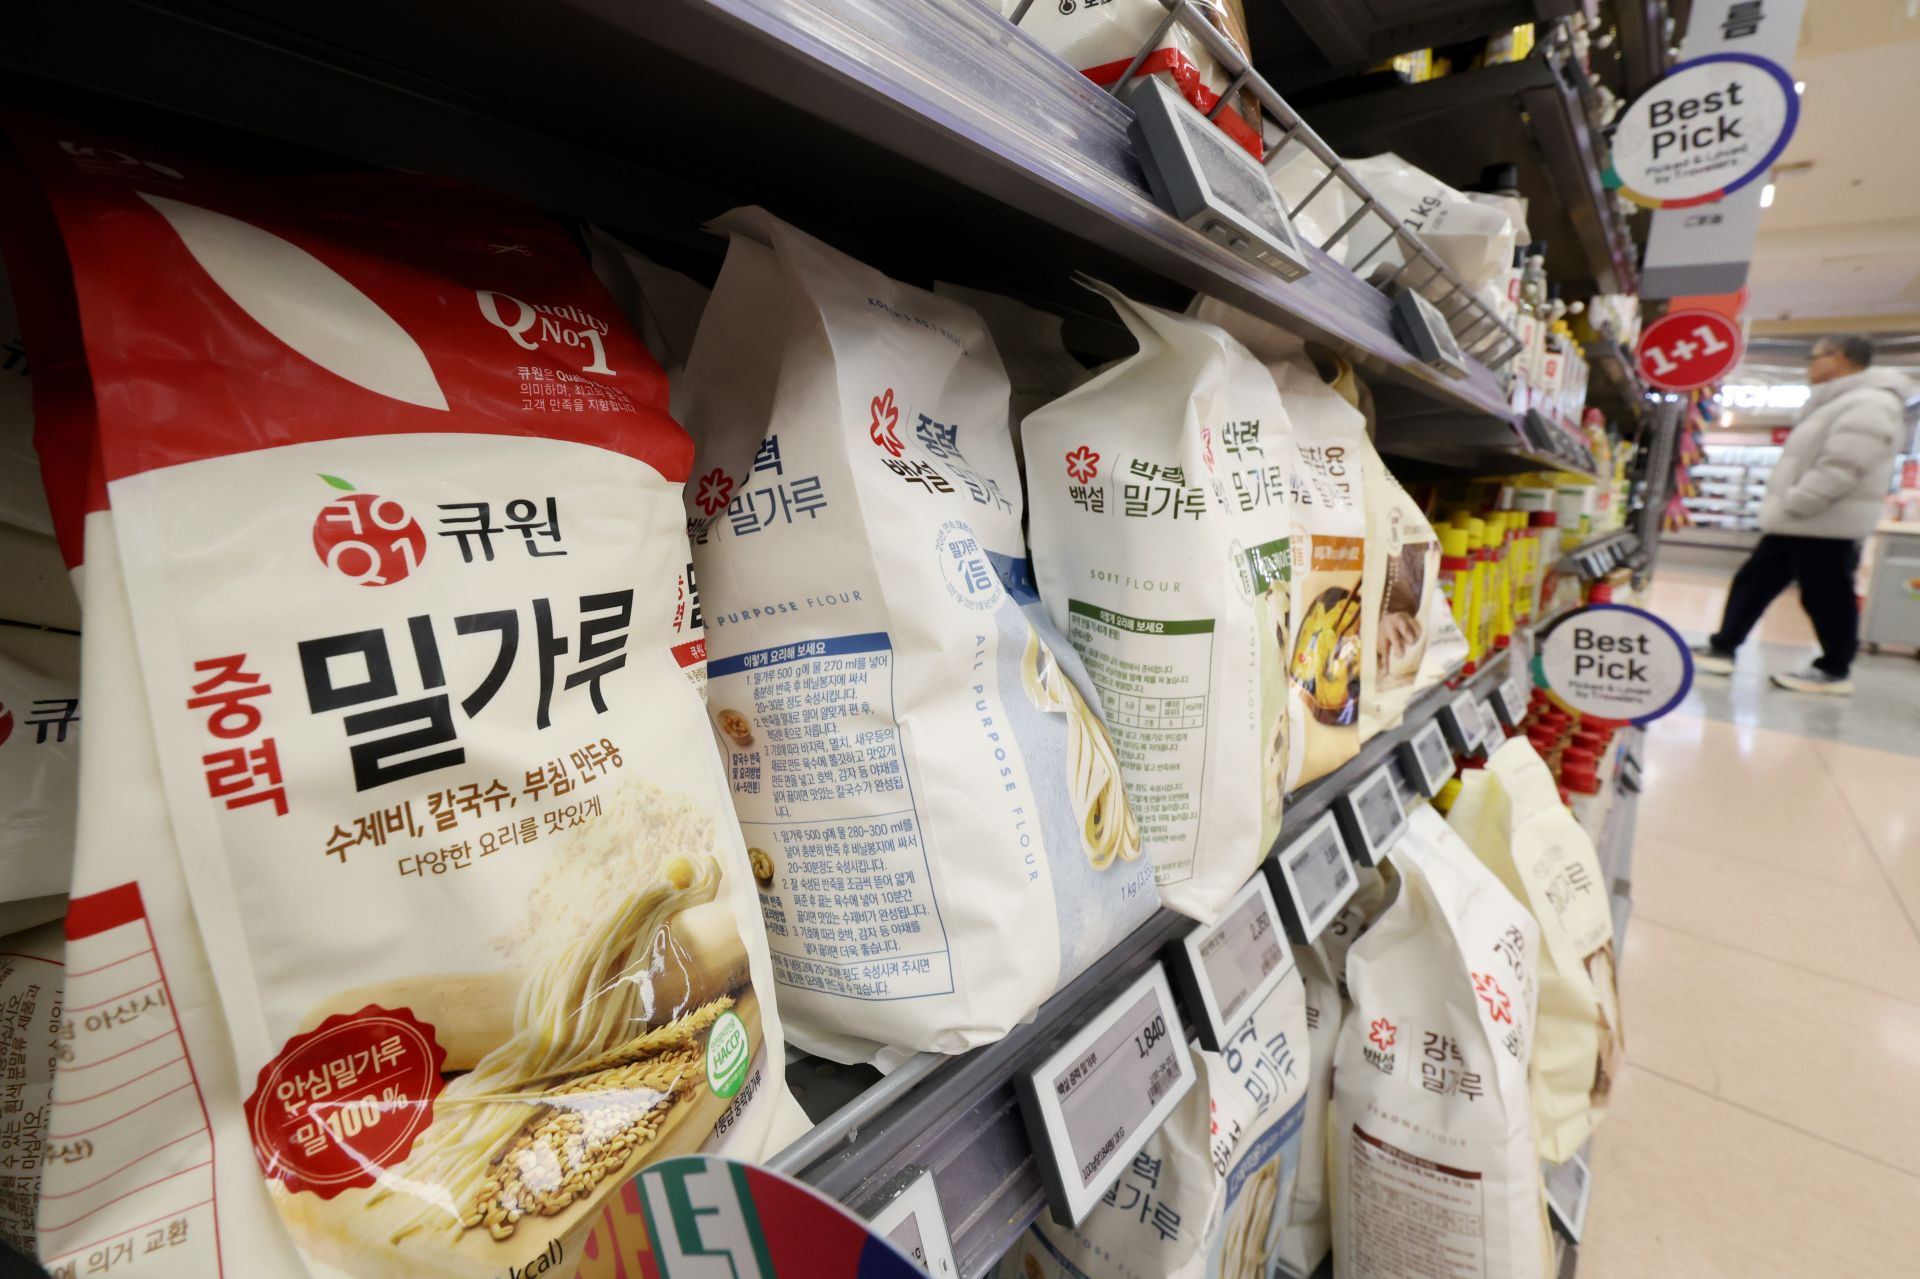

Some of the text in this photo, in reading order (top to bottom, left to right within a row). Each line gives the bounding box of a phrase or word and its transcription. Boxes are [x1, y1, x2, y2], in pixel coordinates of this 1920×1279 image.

[1649, 81, 1743, 129] Best
[1653, 116, 1742, 159] Pick
[476, 290, 609, 351] Quality
[541, 317, 617, 376] No.1
[1646, 325, 1728, 377] 1+1
[517, 366, 555, 381] 큐원은
[520, 383, 572, 398] 의미하며,
[521, 398, 639, 415] 고객 만족을 지향합니다.
[916, 413, 968, 466] 중력
[1222, 420, 1265, 462] 박력
[881, 458, 955, 494] 백설
[945, 462, 1014, 515] 밀가루
[1130, 459, 1186, 487] 박력
[1232, 466, 1285, 512] 밀가루
[727, 476, 827, 537] 밀가루
[1069, 486, 1104, 514] 백설
[1124, 485, 1207, 520] 밀가루
[437, 496, 568, 564] 큐원
[958, 558, 992, 594] 1등
[1090, 569, 1181, 592] SOFT FLOUR
[717, 601, 799, 627] PURPOSE
[807, 590, 863, 609] FLOUR
[1137, 622, 1164, 633] 보세요
[1574, 628, 1650, 655] Best
[744, 642, 826, 667] 이렇게 요리해 보세요
[973, 634, 986, 671] ALL
[1575, 654, 1648, 682] Pick
[754, 656, 888, 685] 밀가루 500 물 270 넣어
[754, 672, 867, 700] 충분히 반죽 비닐봉지에 싸서
[298, 589, 635, 793] 밀가루
[787, 688, 857, 709] 정도 숙성시킵니다.
[24, 699, 81, 744] 큐
[802, 704, 858, 721] 밀어 알맞게 편
[804, 723, 840, 736] 자릅니다.
[187, 652, 290, 817] 중력
[801, 741, 828, 754] 바지락,
[972, 684, 1016, 791] PURPOSE
[803, 744, 897, 770] 육수에 쫄깃하고 맛있게
[839, 760, 899, 781] 감자 야채를
[325, 737, 624, 863] 수제비, 칼국수, 부침, 만두용
[810, 777, 904, 800] 맛있는 칼국수가 완성됩
[398, 794, 603, 878] 다양한 요리를 맛있게
[781, 828, 846, 843] 밀가루 500 물
[802, 835, 917, 858] 충분히 반죽 비닐봉지에 싸서
[1012, 807, 1039, 881] FLOUR
[822, 870, 915, 891] 반죽을 조금씩 뜯어 얇게
[836, 859, 887, 874] 숙성시킵니다.
[818, 904, 930, 925] 맛있는 완성됩니다.
[834, 889, 912, 908] 육수에 넣어 10분간
[859, 921, 921, 940] 감자 야채를
[861, 939, 901, 955] 좋습니다.
[863, 959, 930, 979] 숙성시켜 주시면
[17, 984, 40, 1031] 제품과
[84, 988, 166, 1031] 아산시
[713, 1030, 740, 1069] HACCP
[1134, 1015, 1166, 1059] 1,840
[7, 1036, 28, 1080] 분말류
[277, 1035, 407, 1114] 안심밀가루
[1057, 1053, 1097, 1095] 백설 중력 밀가루
[4, 1083, 26, 1113] 흰색
[2, 1120, 21, 1149] 있는
[22, 1106, 44, 1169] 마십시오.
[714, 1106, 734, 1138] 1등급
[88, 1238, 134, 1273] 의거
[143, 1217, 189, 1254] 교환
